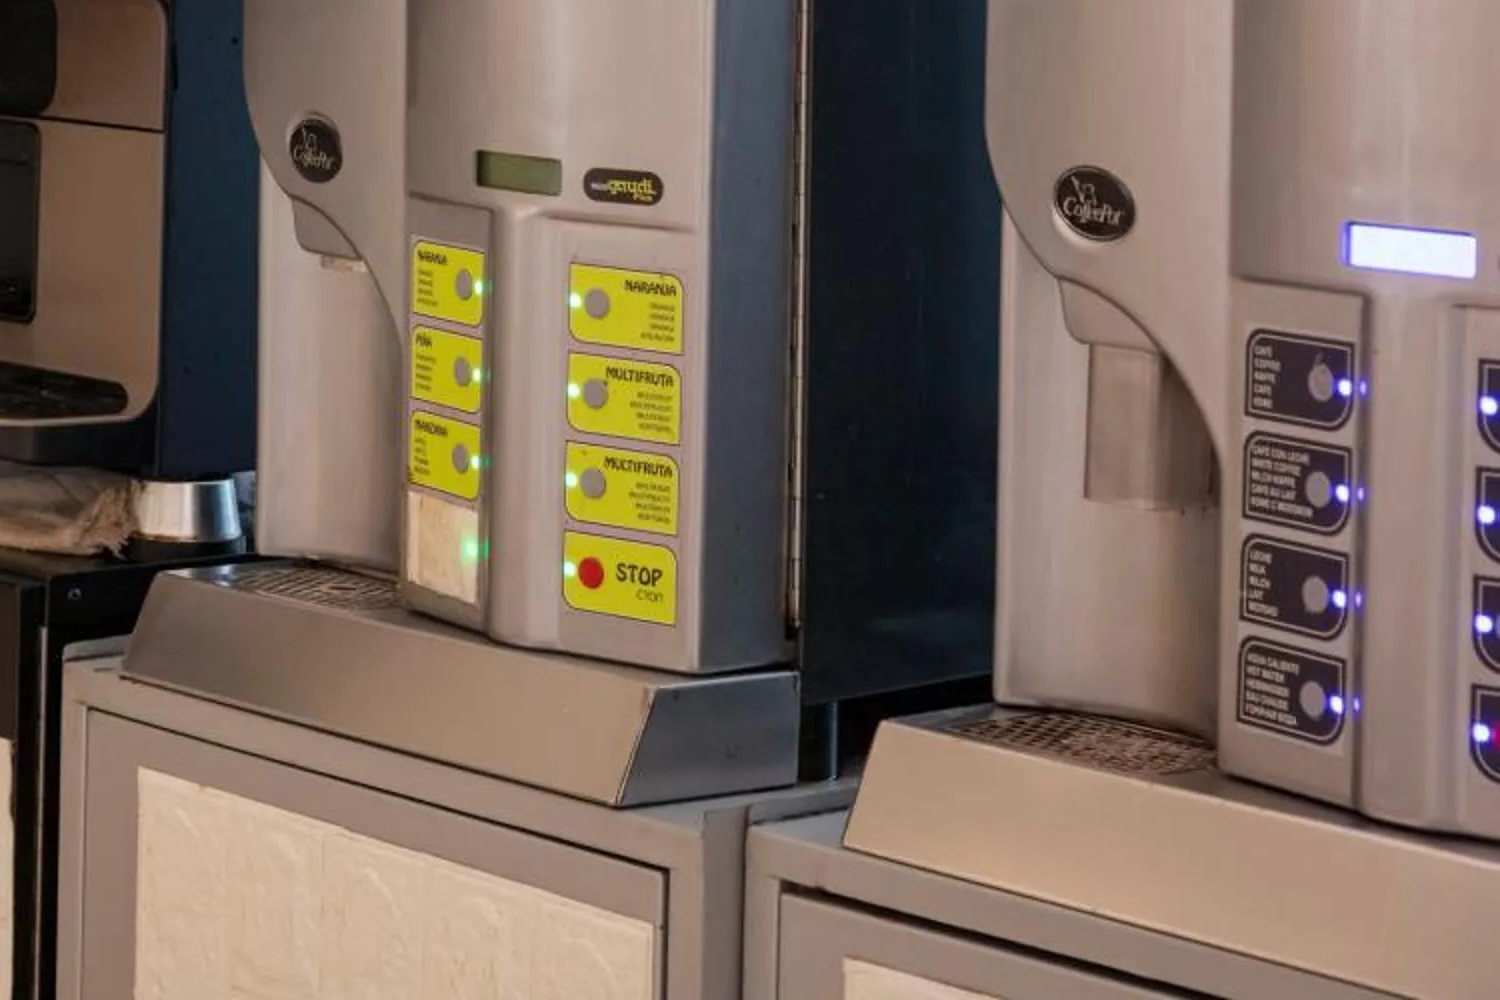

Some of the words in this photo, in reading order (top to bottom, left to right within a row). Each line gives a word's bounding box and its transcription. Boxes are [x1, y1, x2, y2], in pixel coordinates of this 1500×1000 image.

[624, 279, 677, 297] NARANJA
[605, 366, 674, 388] MULTIFRUTA
[603, 456, 673, 479] MULTIFRUTA
[615, 562, 663, 587] STOP
